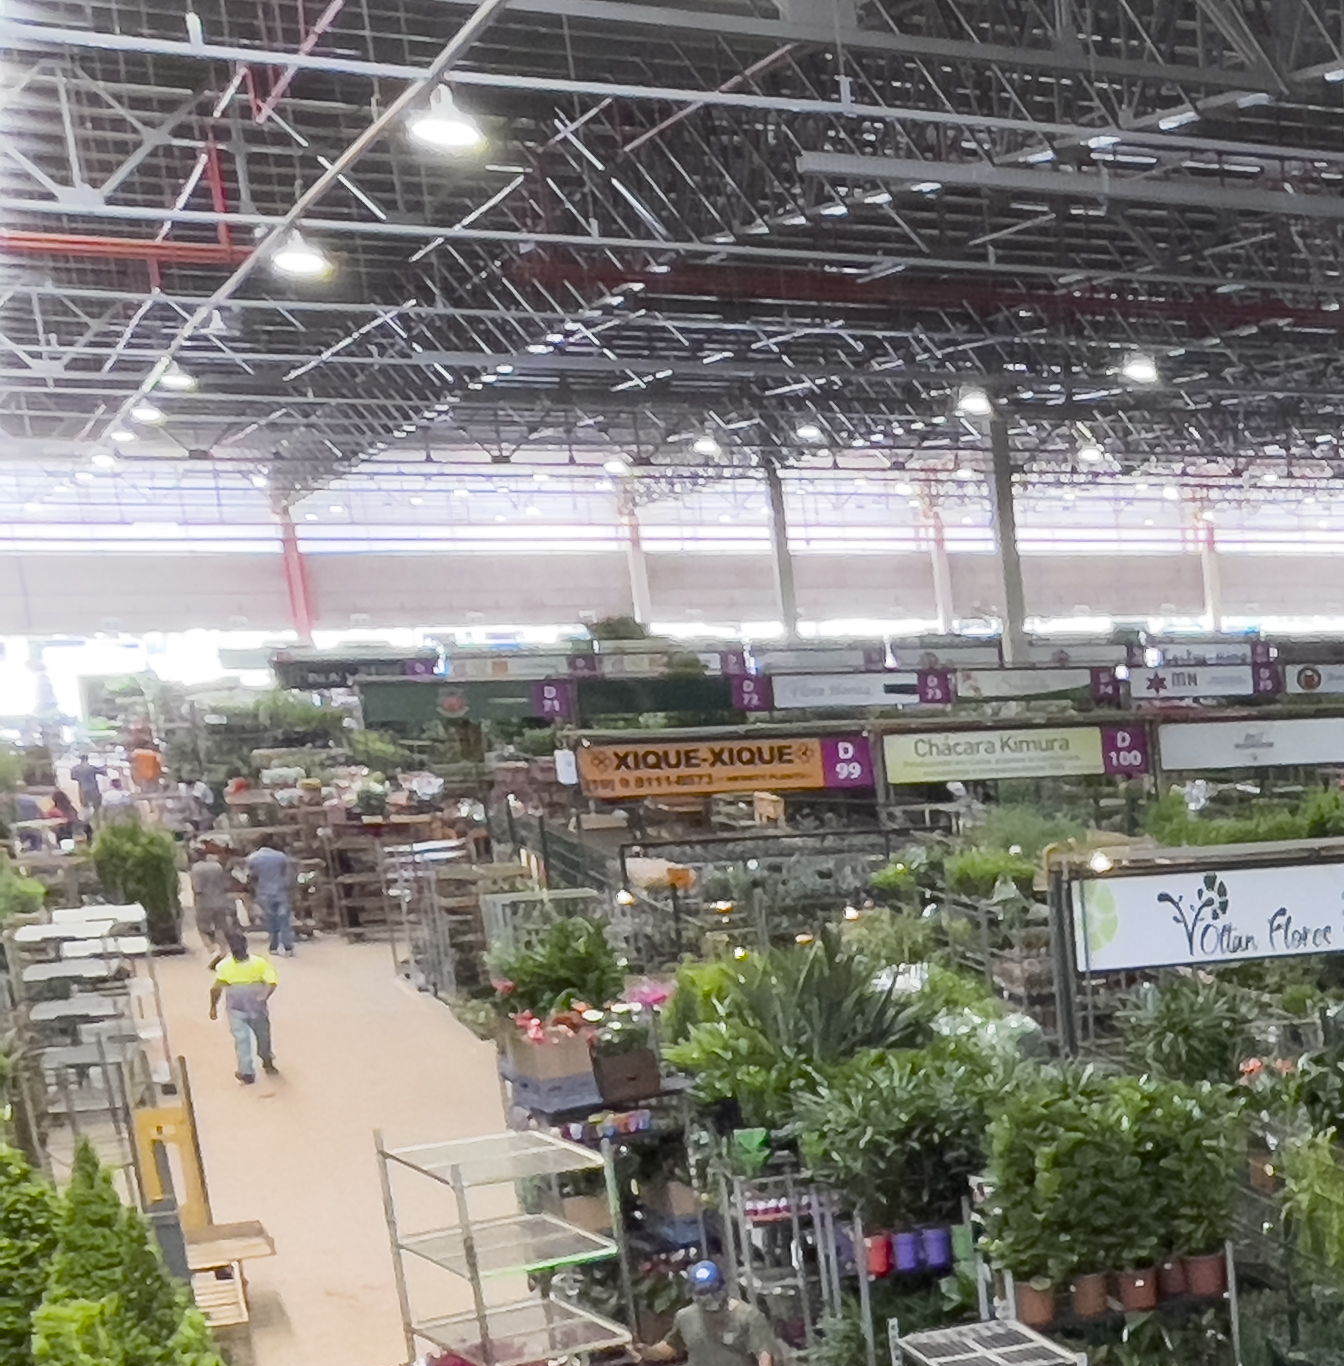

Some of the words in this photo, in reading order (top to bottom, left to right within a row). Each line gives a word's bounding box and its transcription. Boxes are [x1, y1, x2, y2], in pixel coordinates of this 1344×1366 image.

[913, 734, 996, 758] Chácara
[1000, 736, 1070, 753] Kimura
[1116, 731, 1132, 748] D
[612, 744, 796, 772] XIQUE-XIQUE
[836, 741, 855, 760] D
[1109, 750, 1143, 767] 100
[834, 761, 863, 780] 99
